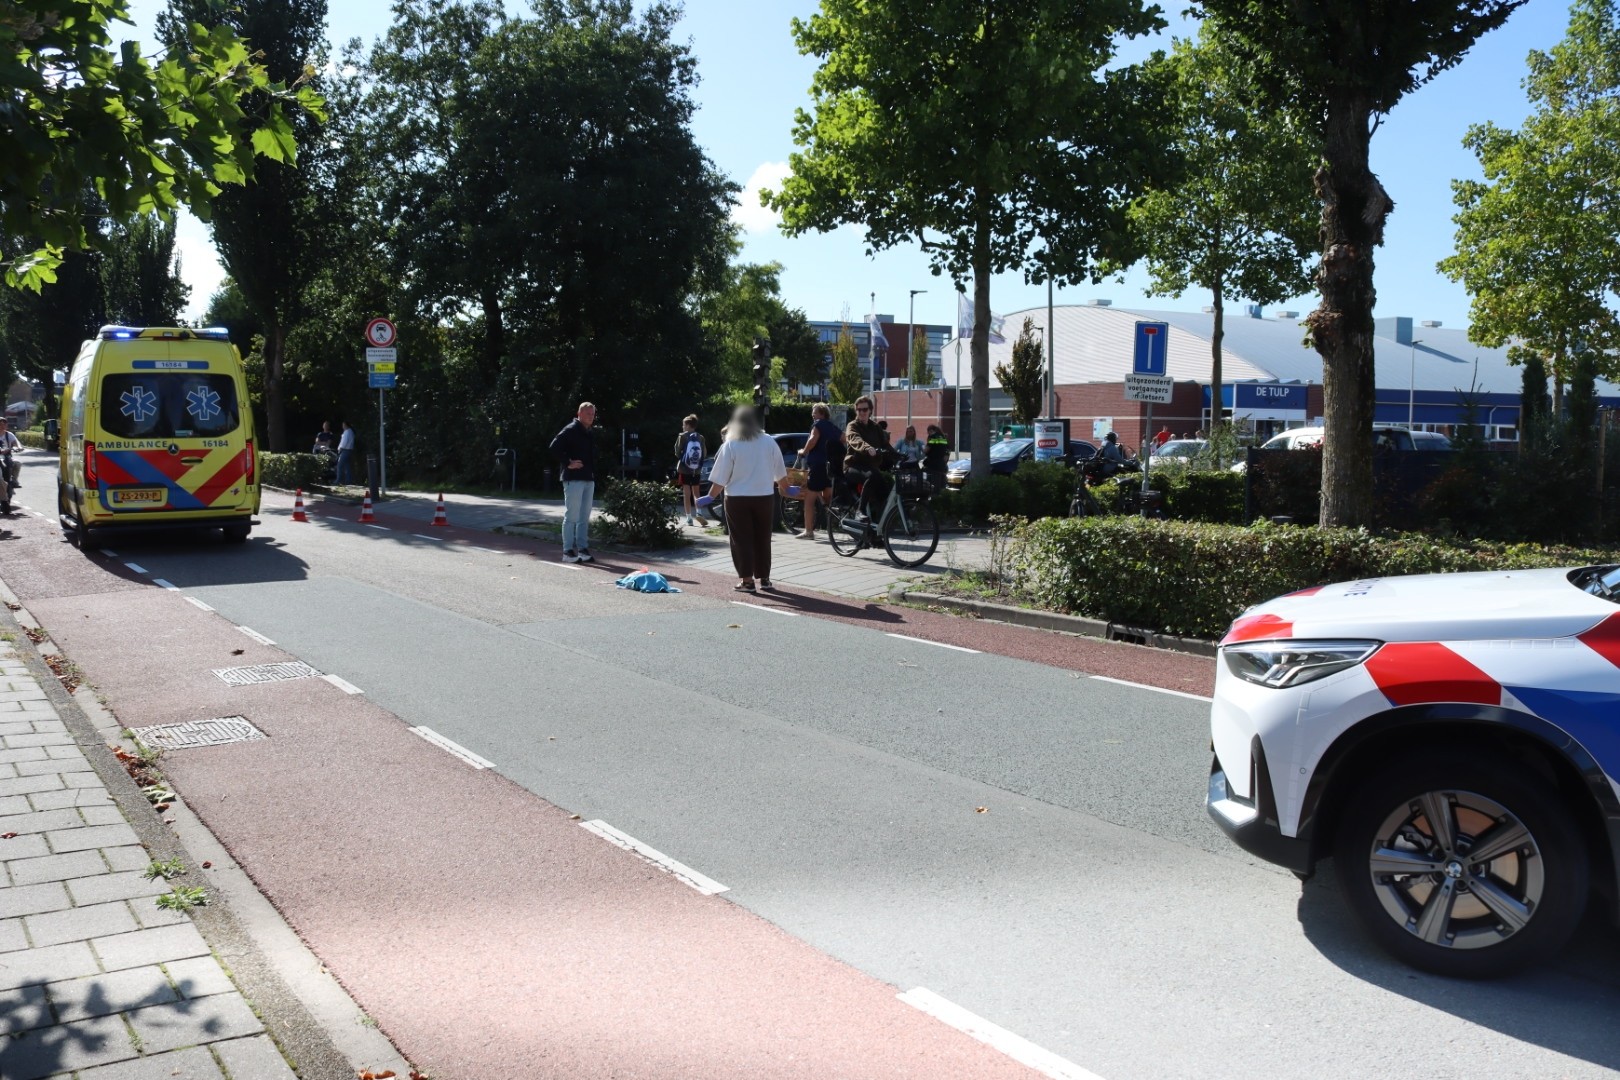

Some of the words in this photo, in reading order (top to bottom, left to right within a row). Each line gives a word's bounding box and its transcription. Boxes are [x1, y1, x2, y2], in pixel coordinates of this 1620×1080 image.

[1126, 377, 1170, 386] uitgezonderd
[1128, 386, 1168, 394] voetgangers
[1256, 386, 1267, 396] DE
[1269, 387, 1290, 397] TULP
[96, 440, 168, 449] AMBULANCE
